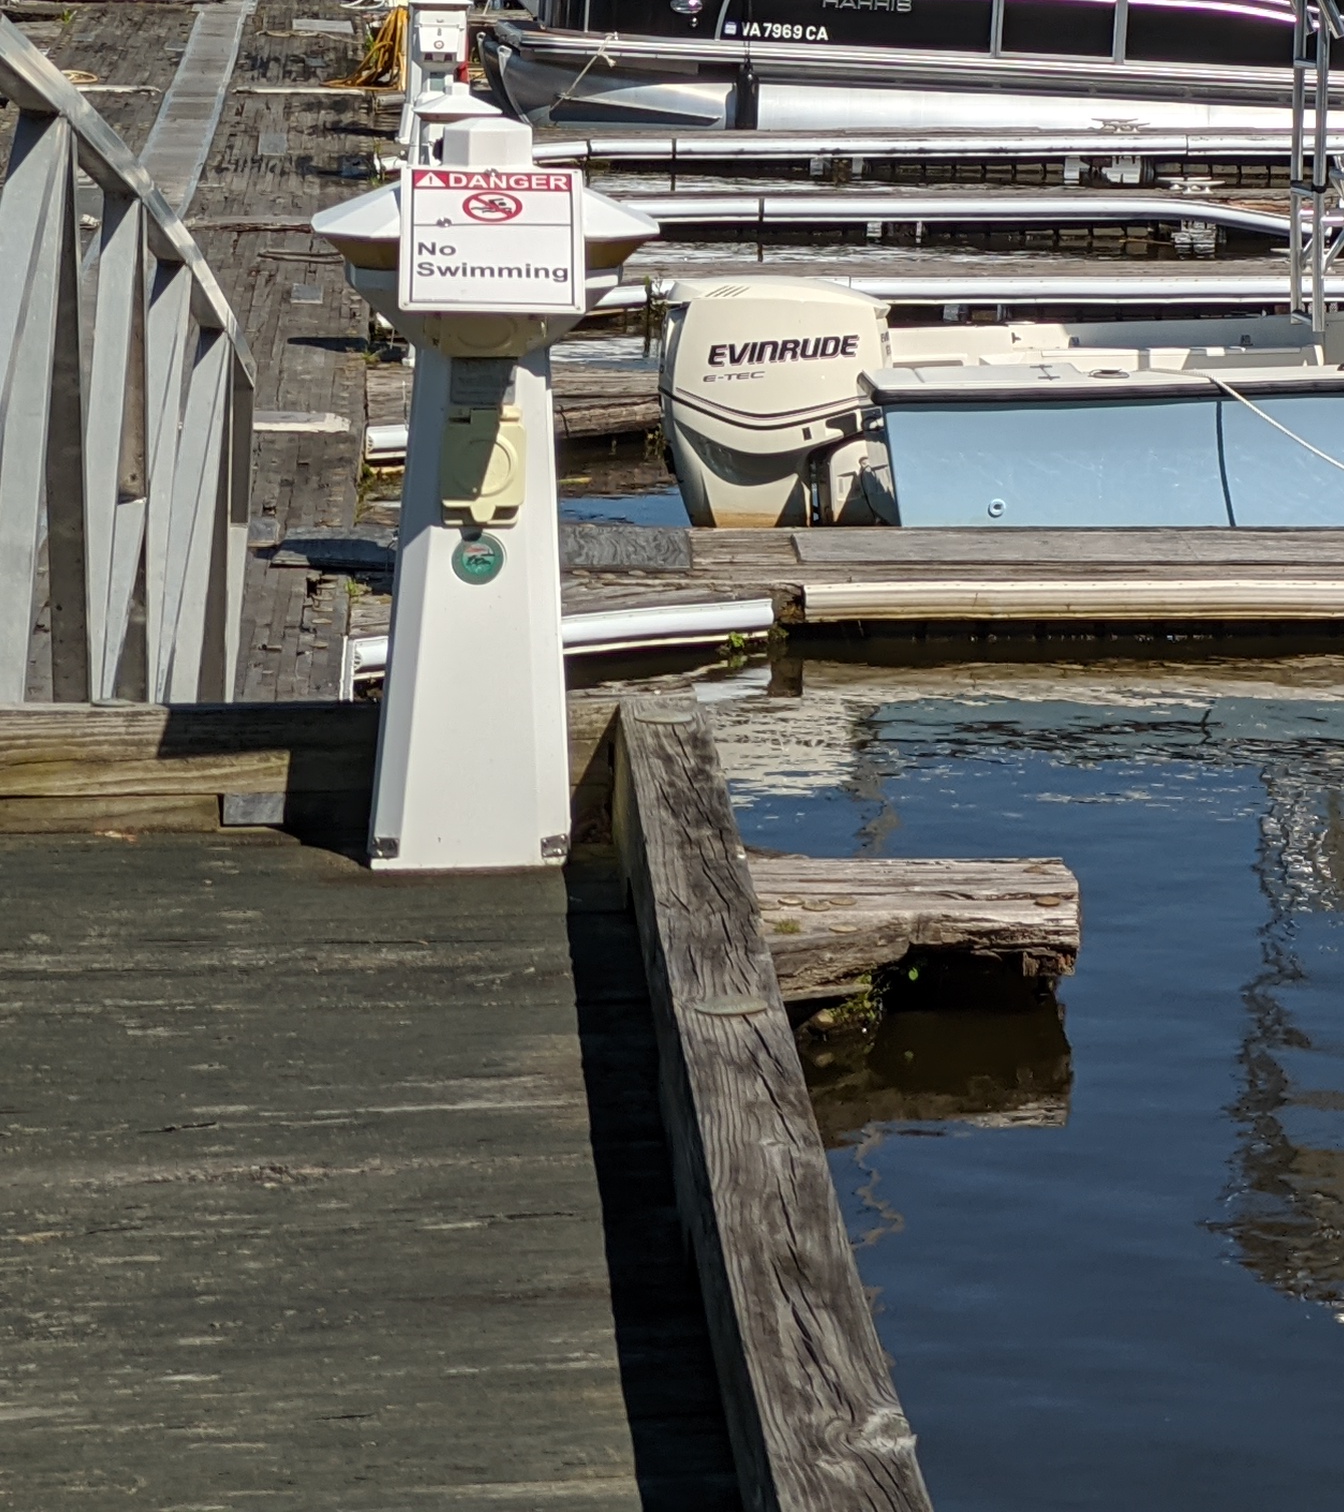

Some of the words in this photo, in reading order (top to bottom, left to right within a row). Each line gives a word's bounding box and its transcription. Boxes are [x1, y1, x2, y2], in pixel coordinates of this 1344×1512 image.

[741, 21, 761, 37] VA
[763, 22, 803, 40] 7969
[805, 25, 829, 41] CA
[448, 173, 569, 190] DANGER
[417, 241, 457, 257] No
[416, 261, 569, 283] Swimming
[707, 334, 860, 368] EVINRUDE
[702, 370, 766, 383] E-TEC
